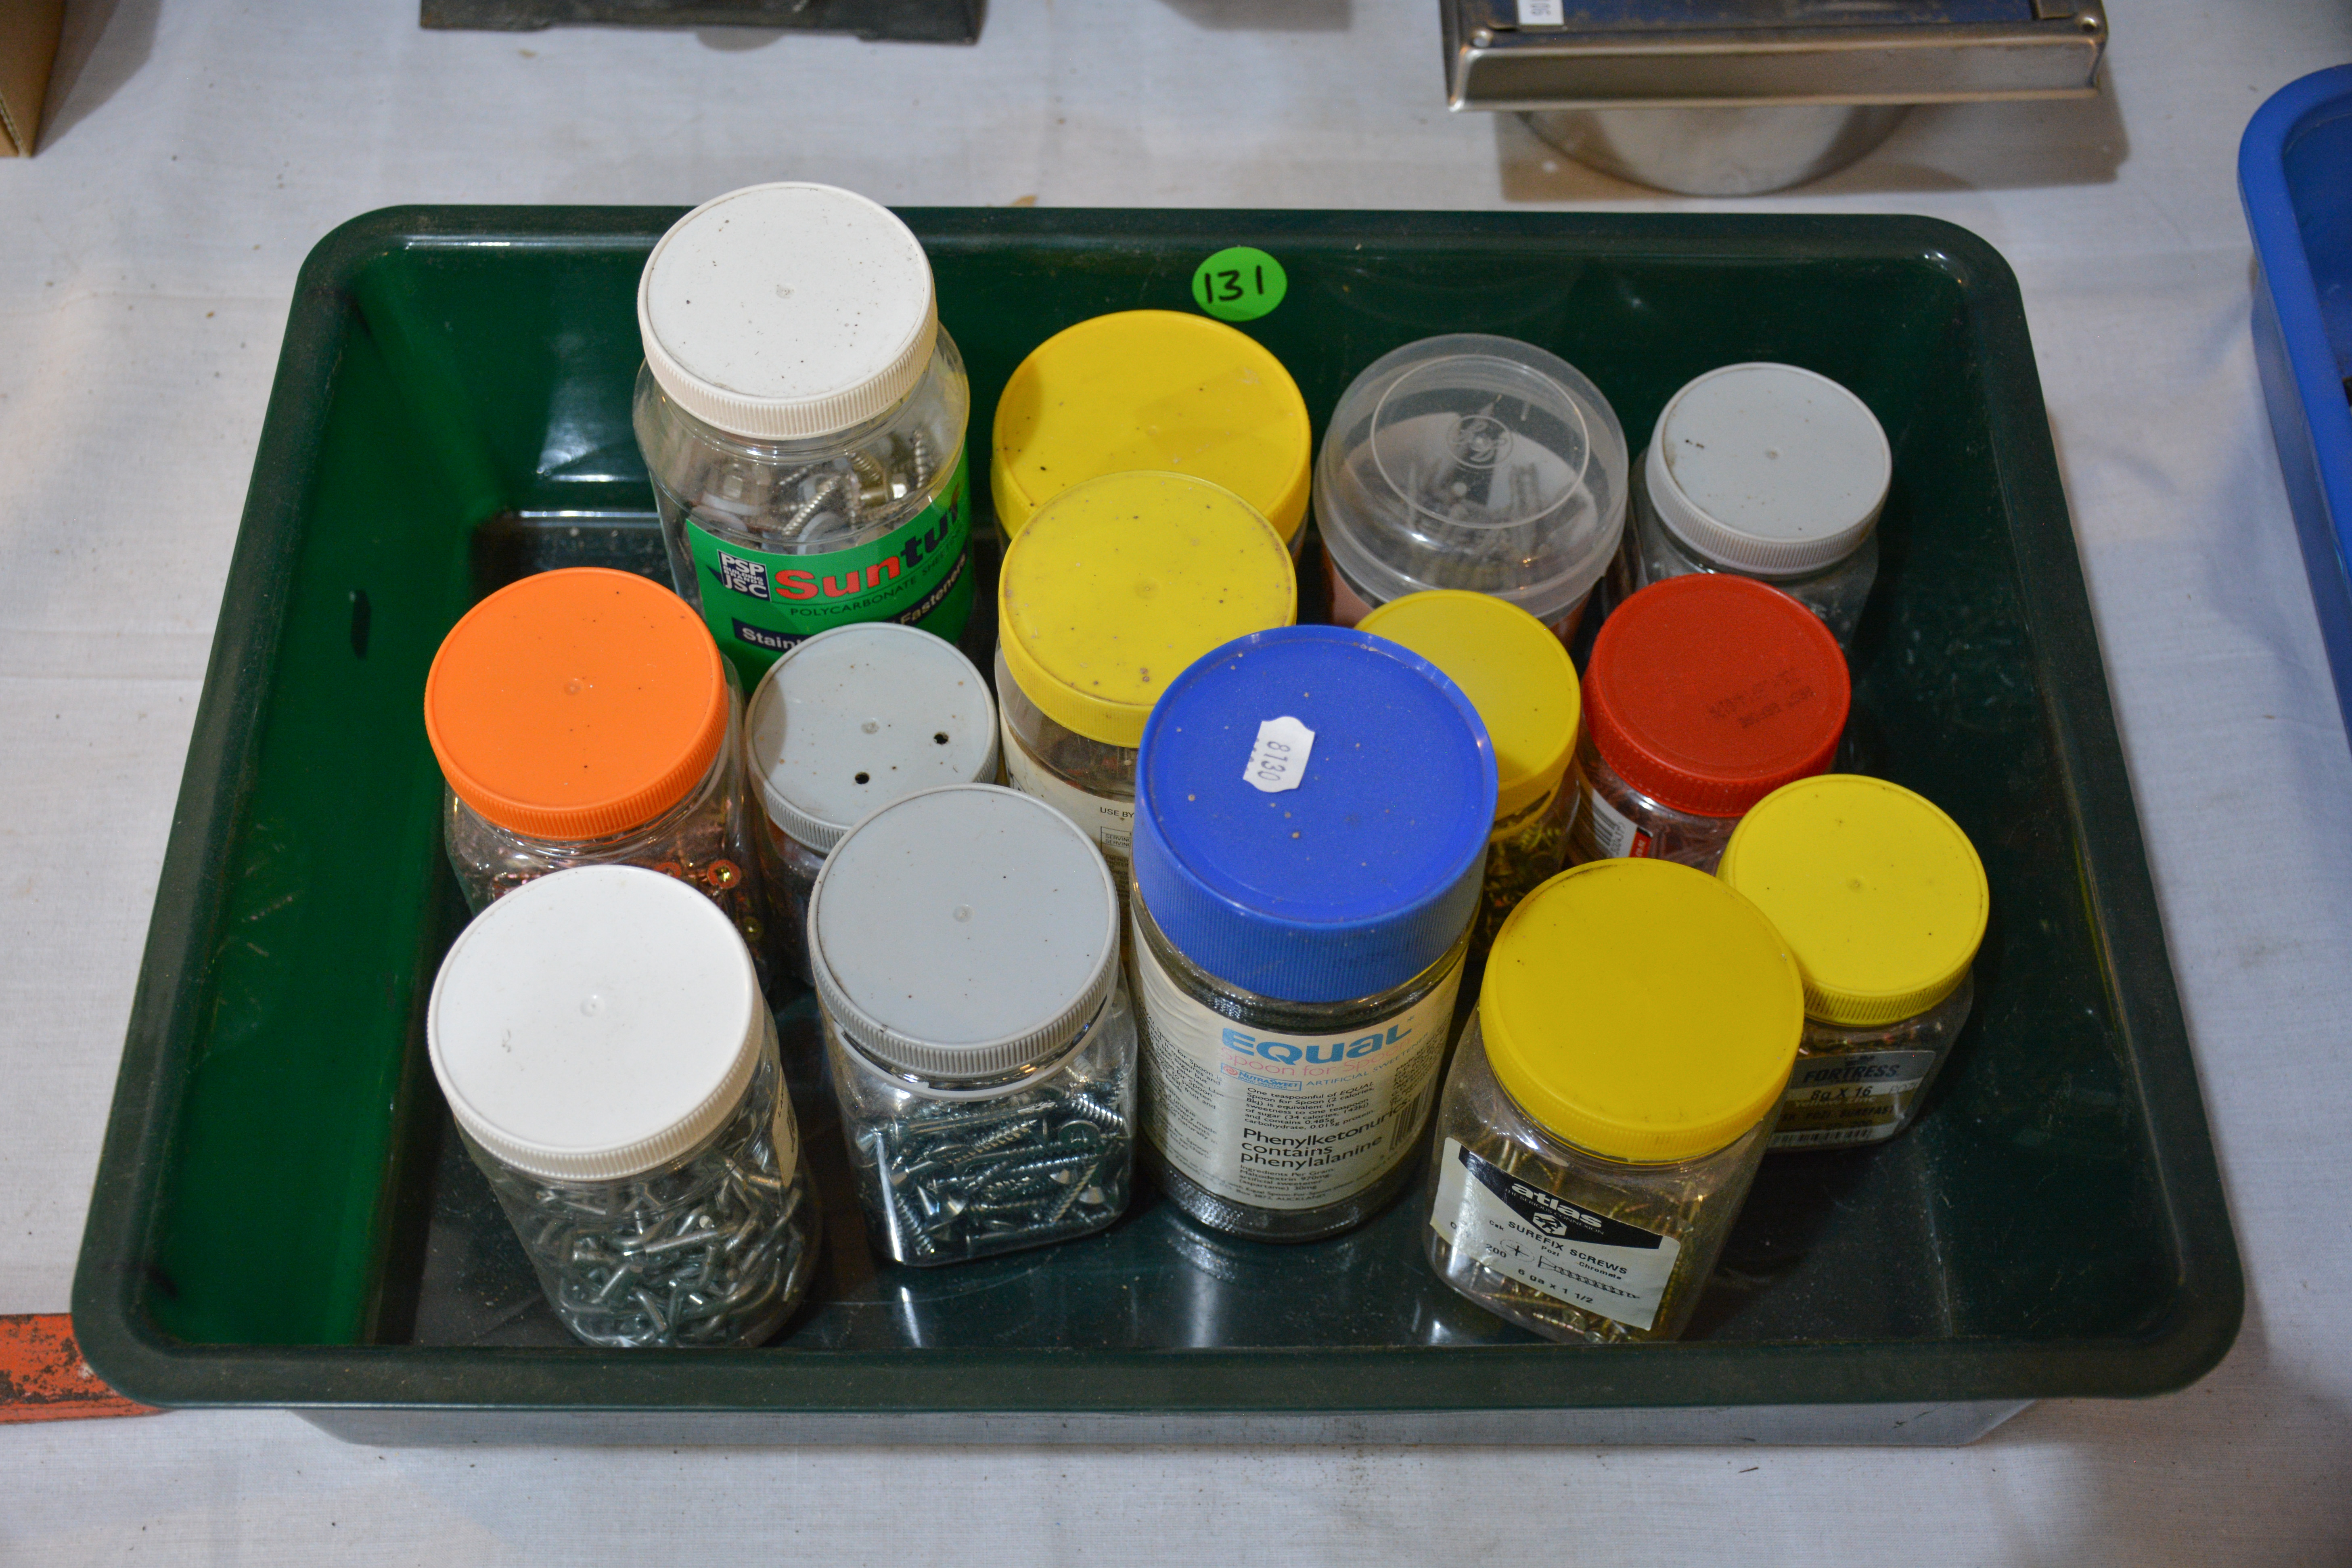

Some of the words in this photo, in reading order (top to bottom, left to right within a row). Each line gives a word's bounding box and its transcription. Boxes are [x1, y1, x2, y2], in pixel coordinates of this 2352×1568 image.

[1205, 265, 1264, 304] 131
[721, 553, 764, 576] PSP
[723, 565, 763, 582] BUILDING
[724, 569, 764, 585] BRANDS
[725, 574, 768, 598] JSC
[900, 552, 966, 625] Fasteners
[791, 576, 916, 615] POLYCARBONATE
[1258, 741, 1290, 781] 8130
[1100, 807, 1119, 816] USE
[1171, 1050, 1204, 1076] measures
[1206, 1076, 1220, 1085] and
[1177, 1049, 1187, 1059] for
[1189, 1059, 1213, 1077] Spoon
[1222, 1047, 1295, 1076] Spoon
[1304, 1065, 1336, 1076] for
[1343, 1038, 1410, 1072] Spoon
[1306, 1071, 1369, 1086] ARTIFICIAL
[1373, 1032, 1429, 1072] SWEETENER
[1174, 1058, 1192, 1073] sugar
[1195, 1073, 1207, 1084] but
[1803, 1064, 1901, 1083] FORTRESS
[1172, 1071, 1179, 1079] to
[1182, 1080, 1212, 1102] sweeten
[1176, 1070, 1186, 1079] for
[1189, 1079, 1212, 1097] Spoon
[1340, 1082, 1373, 1095] EQUAL
[1856, 1086, 1873, 1097] 16
[1174, 1099, 1196, 1117] unique
[1184, 1087, 1199, 1101] fruit
[1202, 1100, 1216, 1110] and
[1246, 1103, 1291, 1114] sweetness
[1330, 1099, 1369, 1112] teaspoon
[1247, 1093, 1275, 1102] Spoon
[1178, 1118, 1208, 1139] naturally
[1197, 1121, 1217, 1134] made
[1241, 1136, 1382, 1171] phenylalanine
[1242, 1142, 1333, 1157] contains
[1240, 1170, 1296, 1181] Maltodextrin
[1240, 1175, 1272, 1184] artificial
[1241, 1164, 1288, 1177] Ingredients
[1239, 1179, 1289, 1191] (aspartame)
[1512, 1183, 1602, 1228] atlas
[1519, 1195, 1553, 1213] SERIOUS
[1555, 1212, 1604, 1235] CONNEXION
[1486, 1244, 1507, 1258] 200
[1489, 1220, 1504, 1231] Csk
[1508, 1221, 1564, 1251] SUREFIX
[1569, 1249, 1628, 1274] SCREWS
[1579, 1261, 1622, 1280] Chromate
[1530, 1275, 1544, 1285] ga
[1575, 1293, 1593, 1304] 1/2
